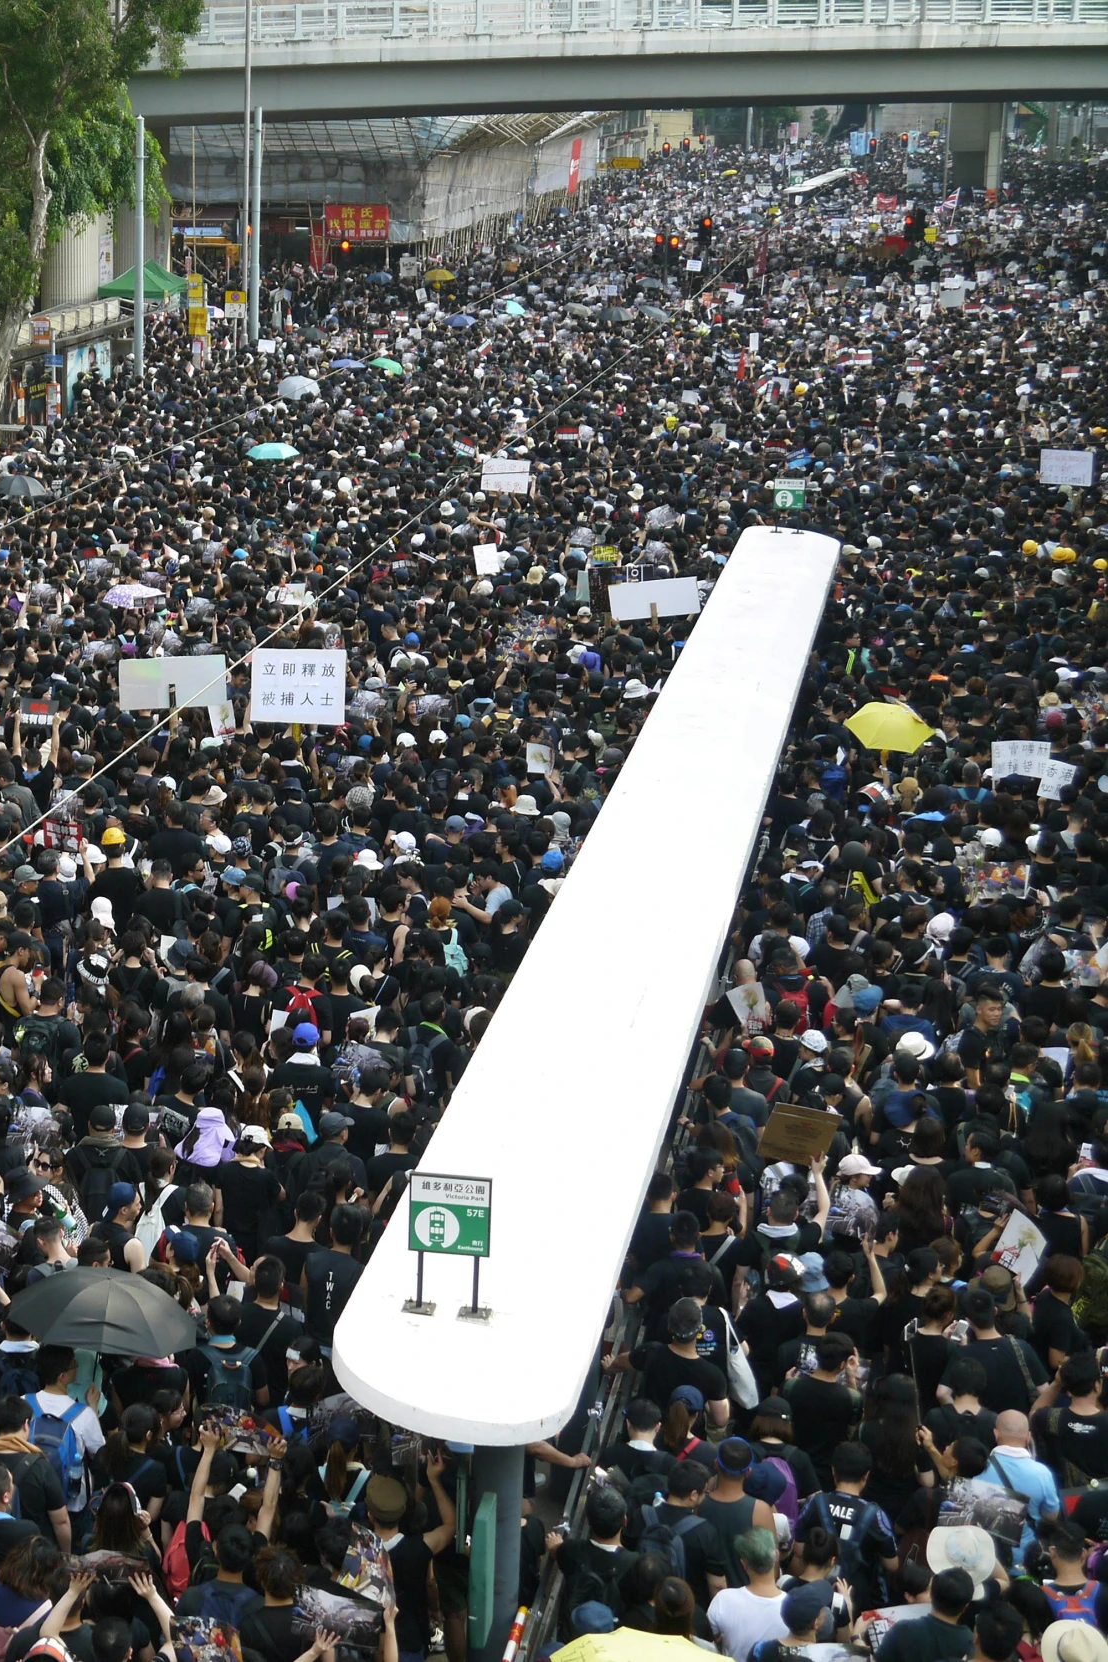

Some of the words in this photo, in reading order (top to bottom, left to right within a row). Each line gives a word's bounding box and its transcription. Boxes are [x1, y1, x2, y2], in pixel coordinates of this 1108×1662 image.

[342, 207, 373, 218] 許氏
[262, 662, 336, 678] 立即釋放
[262, 691, 334, 706] 被捕人士
[1047, 764, 1074, 782] 香港
[422, 1181, 485, 1194] 維多利亞公園
[466, 1208, 484, 1218] 57E
[326, 1271, 334, 1310] TWAC
